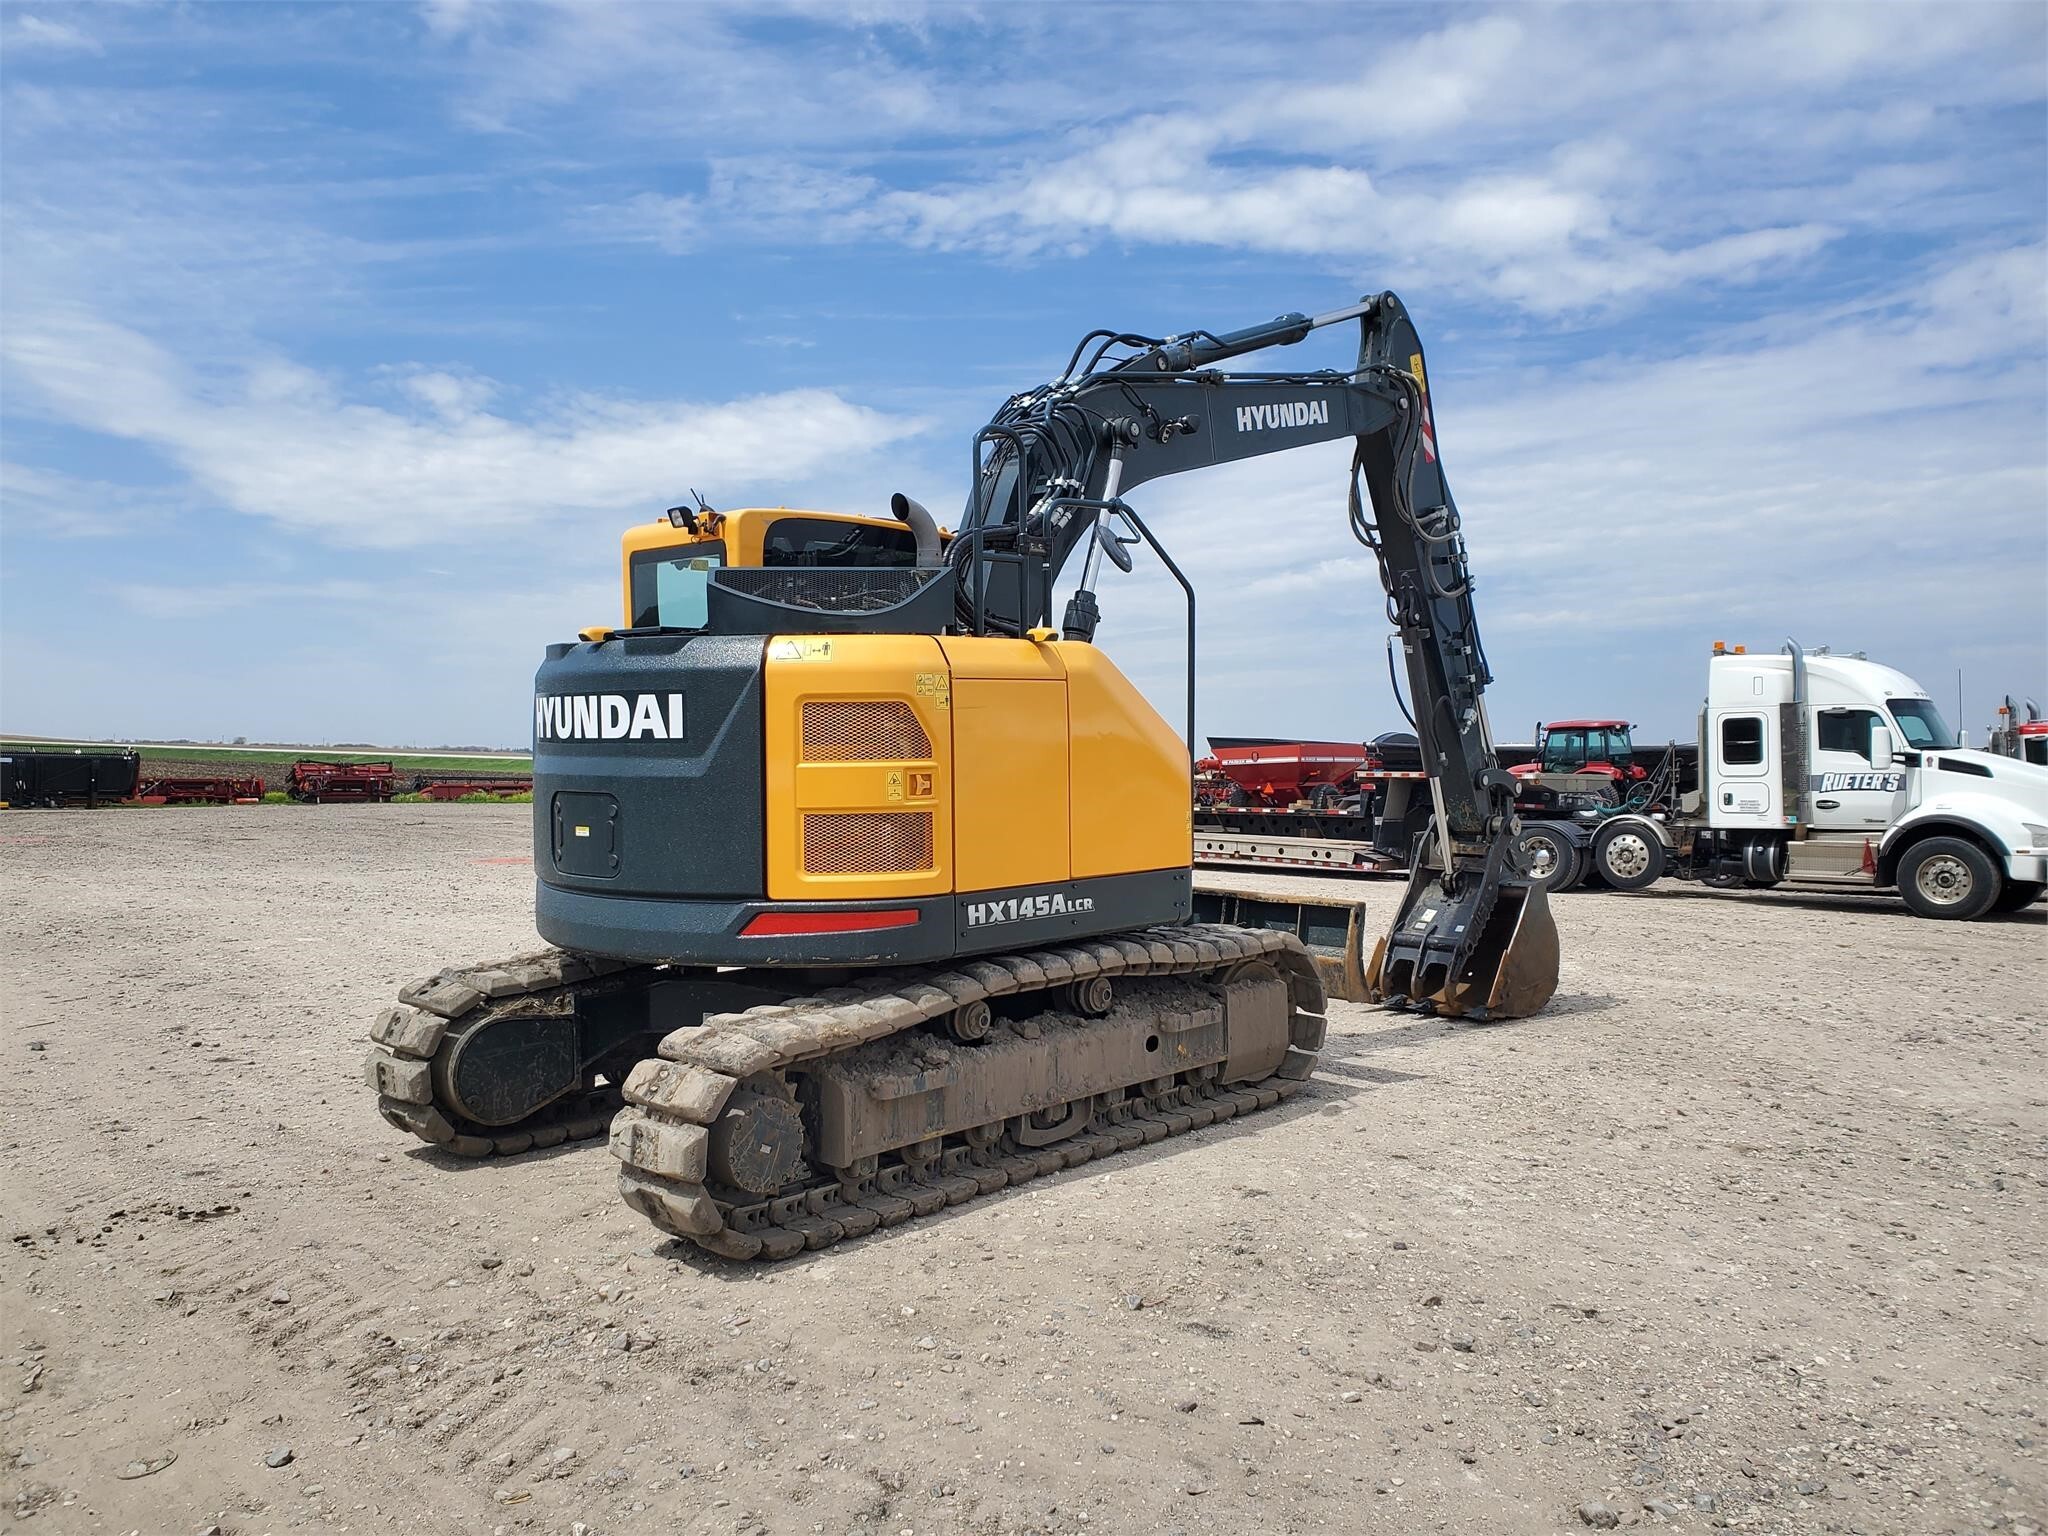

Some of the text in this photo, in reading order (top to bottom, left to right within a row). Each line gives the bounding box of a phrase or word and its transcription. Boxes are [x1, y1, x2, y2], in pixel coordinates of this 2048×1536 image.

[1236, 400, 1328, 432] HYUNDAI
[536, 693, 683, 739] HYUNDAI
[1820, 773, 1900, 792] RUETER'S
